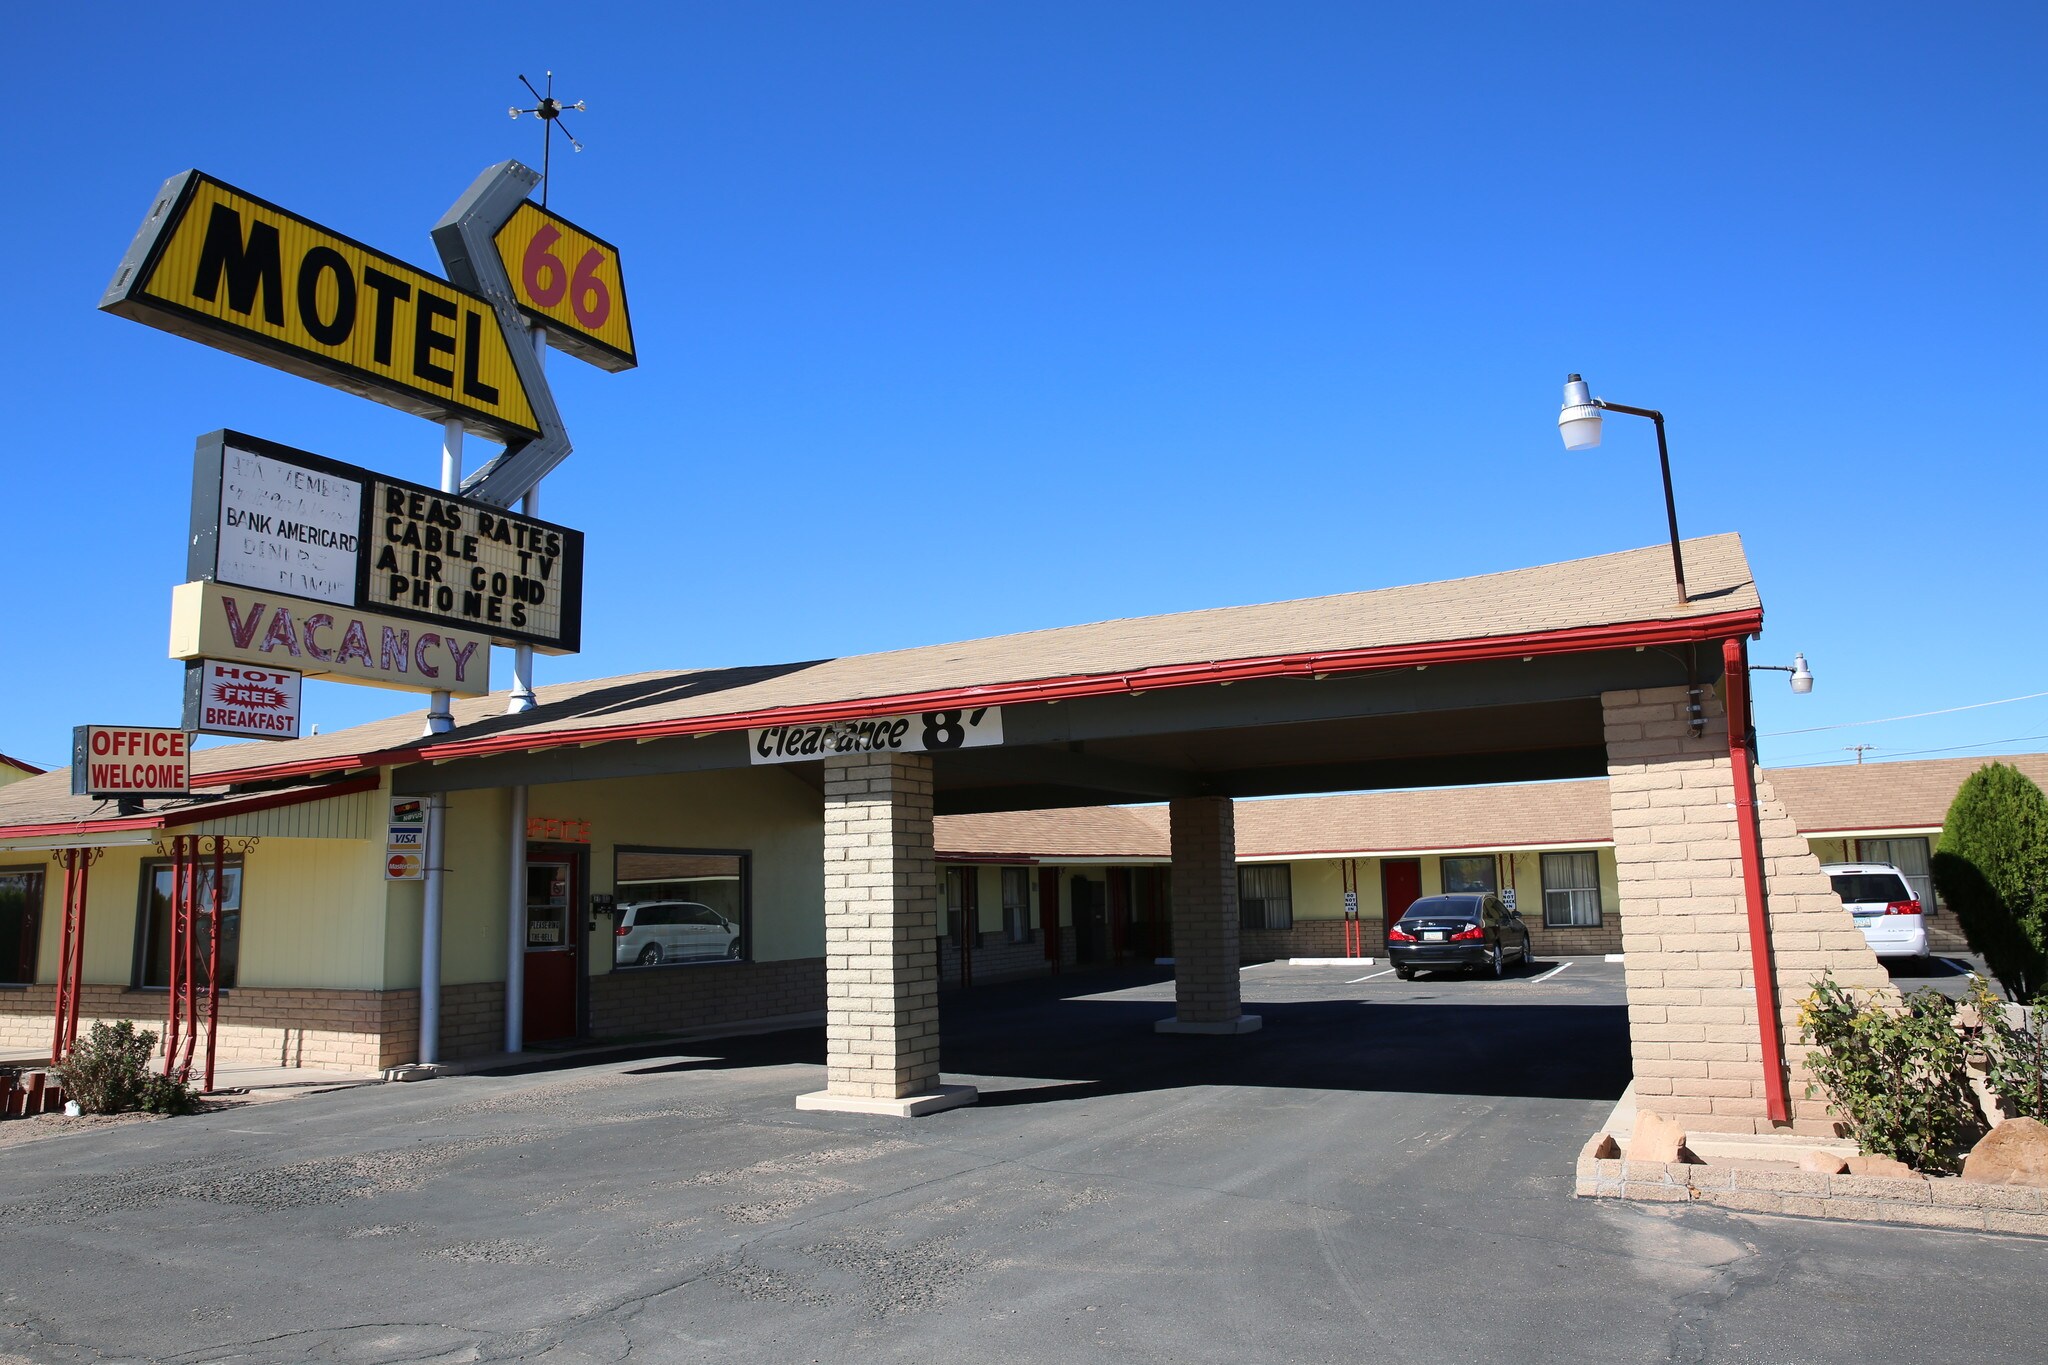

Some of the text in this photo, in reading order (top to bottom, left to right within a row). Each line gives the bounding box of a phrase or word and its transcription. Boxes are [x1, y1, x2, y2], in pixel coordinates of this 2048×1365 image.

[522, 222, 611, 330] 66
[192, 202, 500, 406] MOTEL
[227, 507, 359, 553] BANK AMERICARD
[386, 486, 462, 531] REAS
[479, 511, 561, 557] RATES
[386, 516, 554, 580] CABLE TV
[376, 545, 545, 606] AIR COND
[389, 574, 527, 627] PHONES
[221, 596, 478, 682] VACANCY
[215, 666, 291, 685] HOT
[224, 687, 277, 705] FREE
[92, 731, 184, 757] OFFICE
[206, 708, 294, 731] BREAKFAST
[92, 764, 184, 789] WELCOME
[395, 834, 417, 844] VISA
